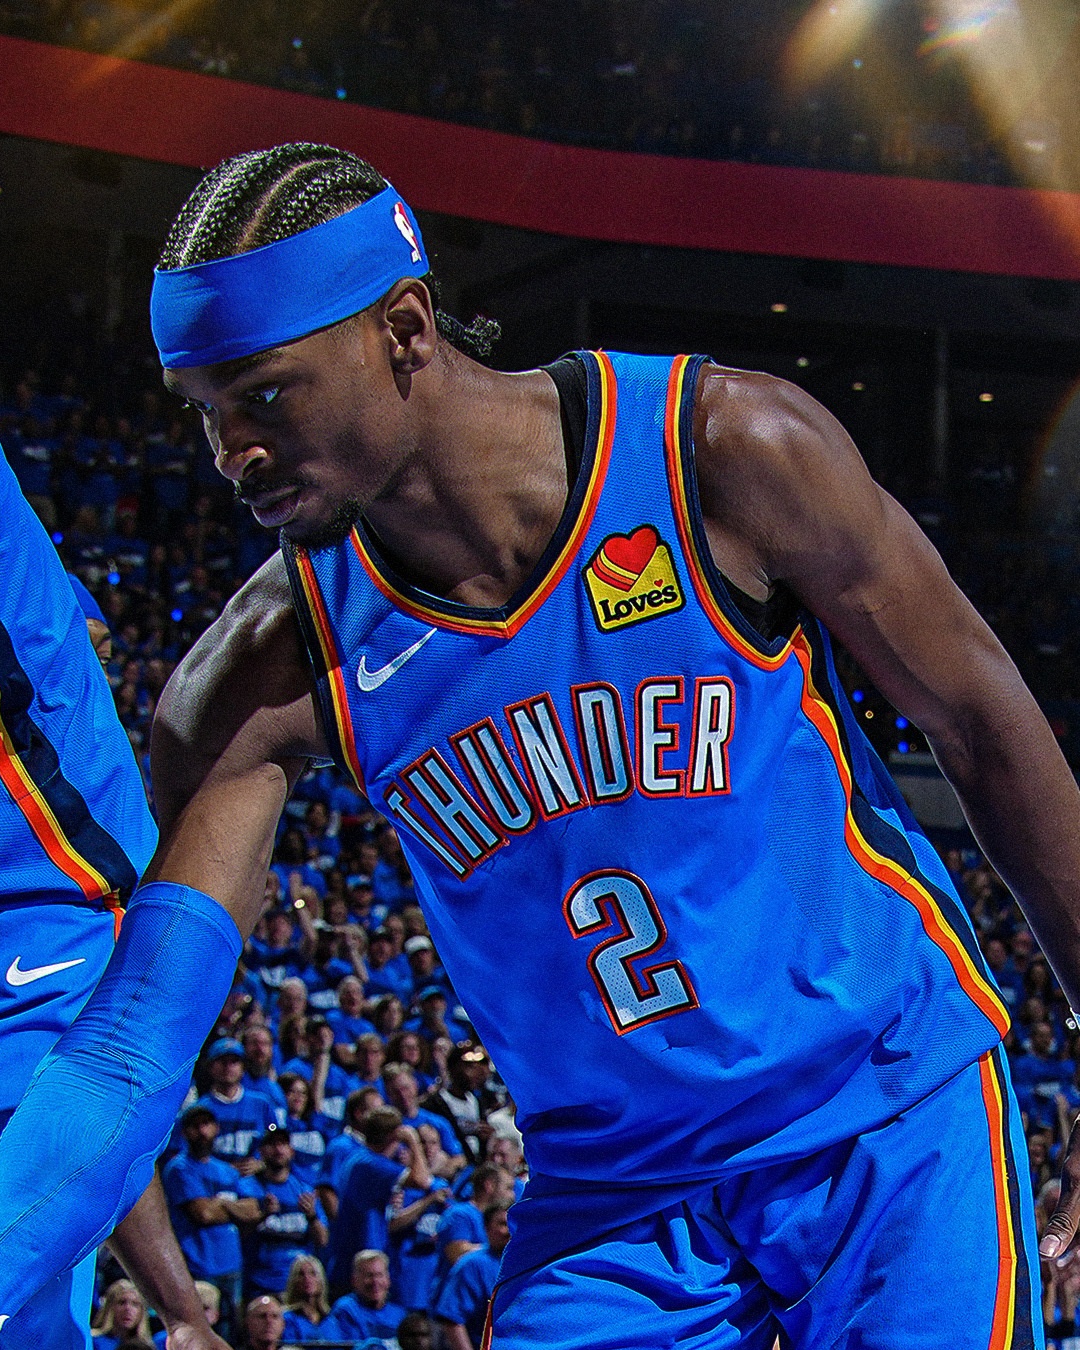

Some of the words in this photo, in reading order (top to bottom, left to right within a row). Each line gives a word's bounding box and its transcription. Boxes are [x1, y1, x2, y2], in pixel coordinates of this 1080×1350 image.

[598, 579, 679, 625] Love's
[383, 675, 736, 882] THUNDER
[562, 868, 700, 1036] 2
